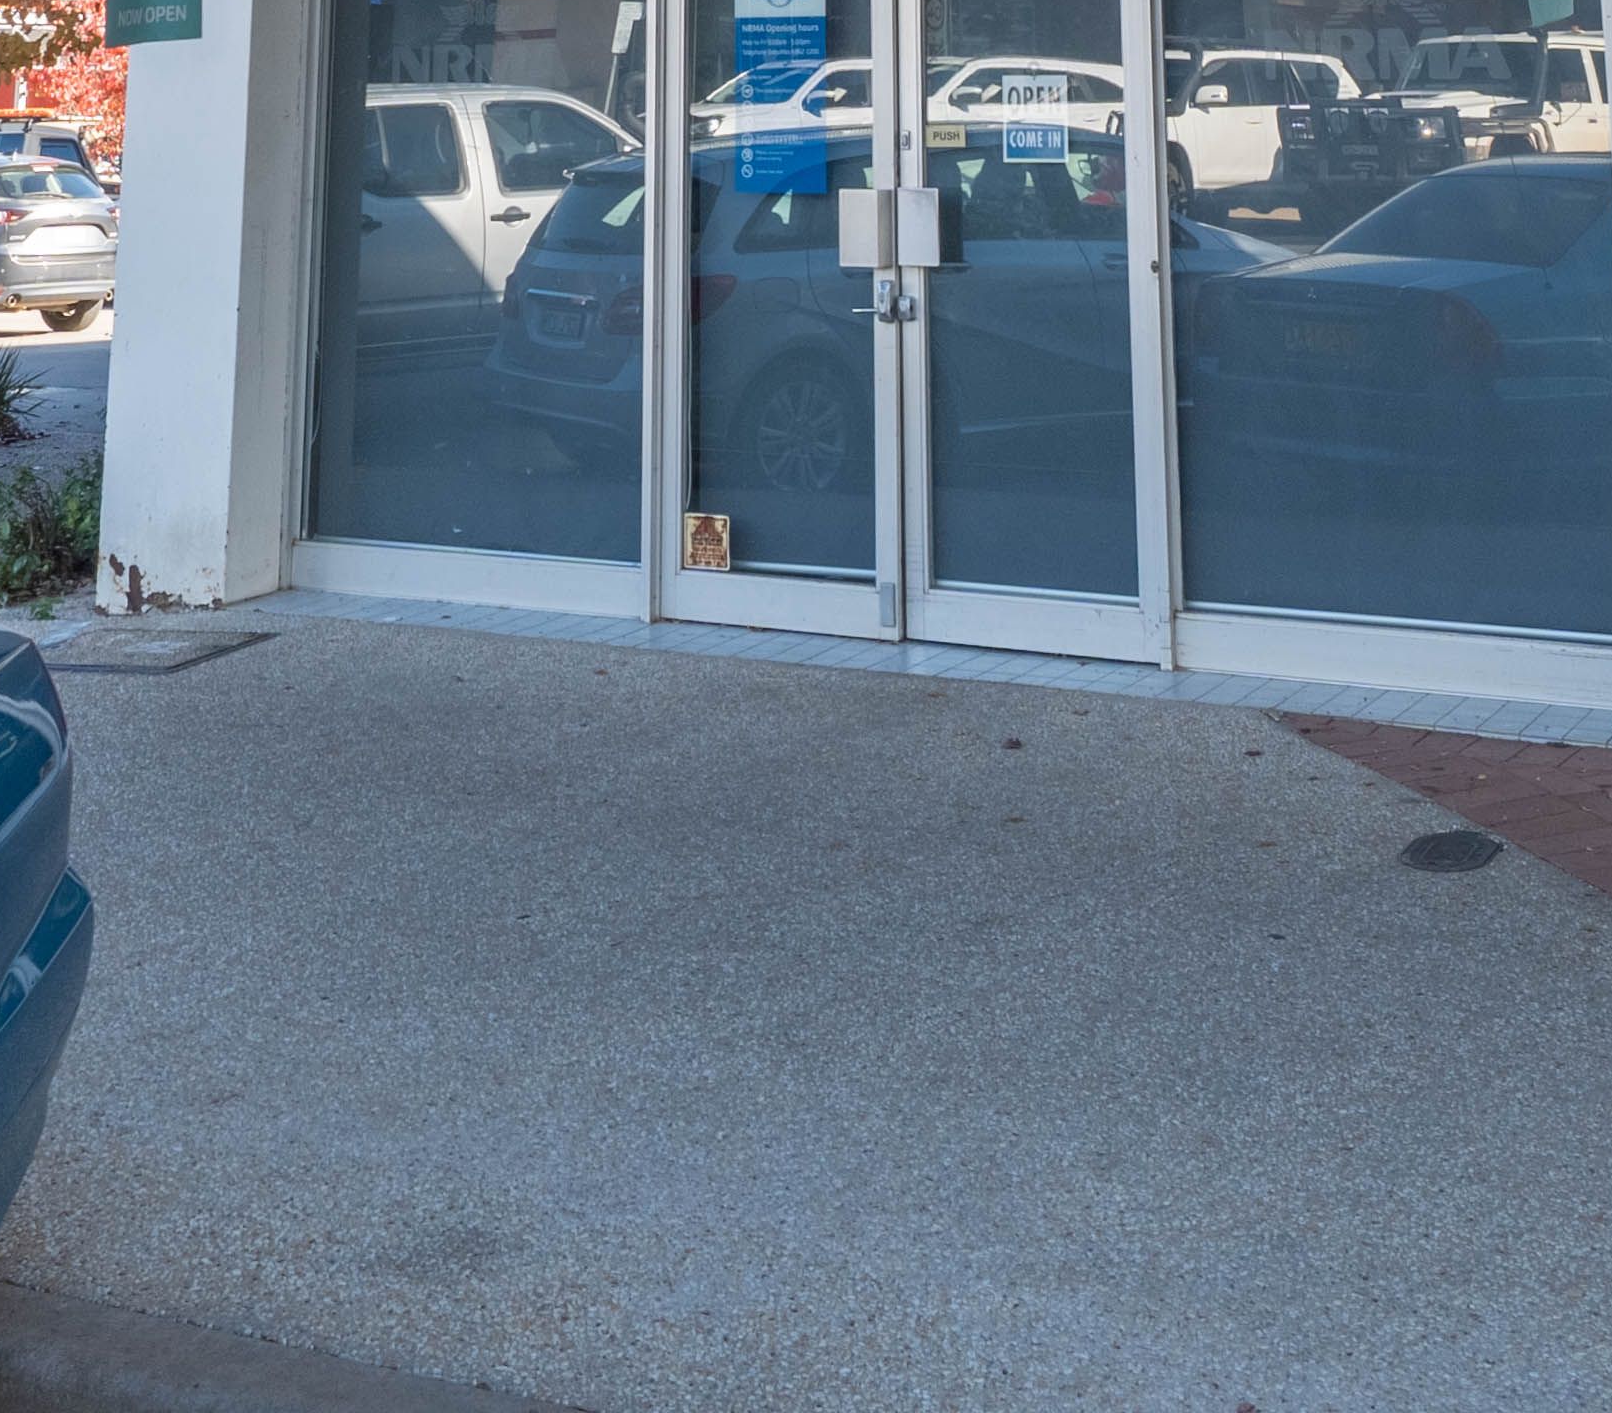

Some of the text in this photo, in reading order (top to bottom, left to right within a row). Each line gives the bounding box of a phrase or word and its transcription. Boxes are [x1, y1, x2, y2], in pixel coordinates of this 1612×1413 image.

[118, 4, 187, 27] NOW OPEN
[1265, 27, 1513, 81] NRMA
[1008, 85, 1061, 113] OPEN
[933, 132, 960, 141] PUSH
[1009, 130, 1062, 148] COME IN
